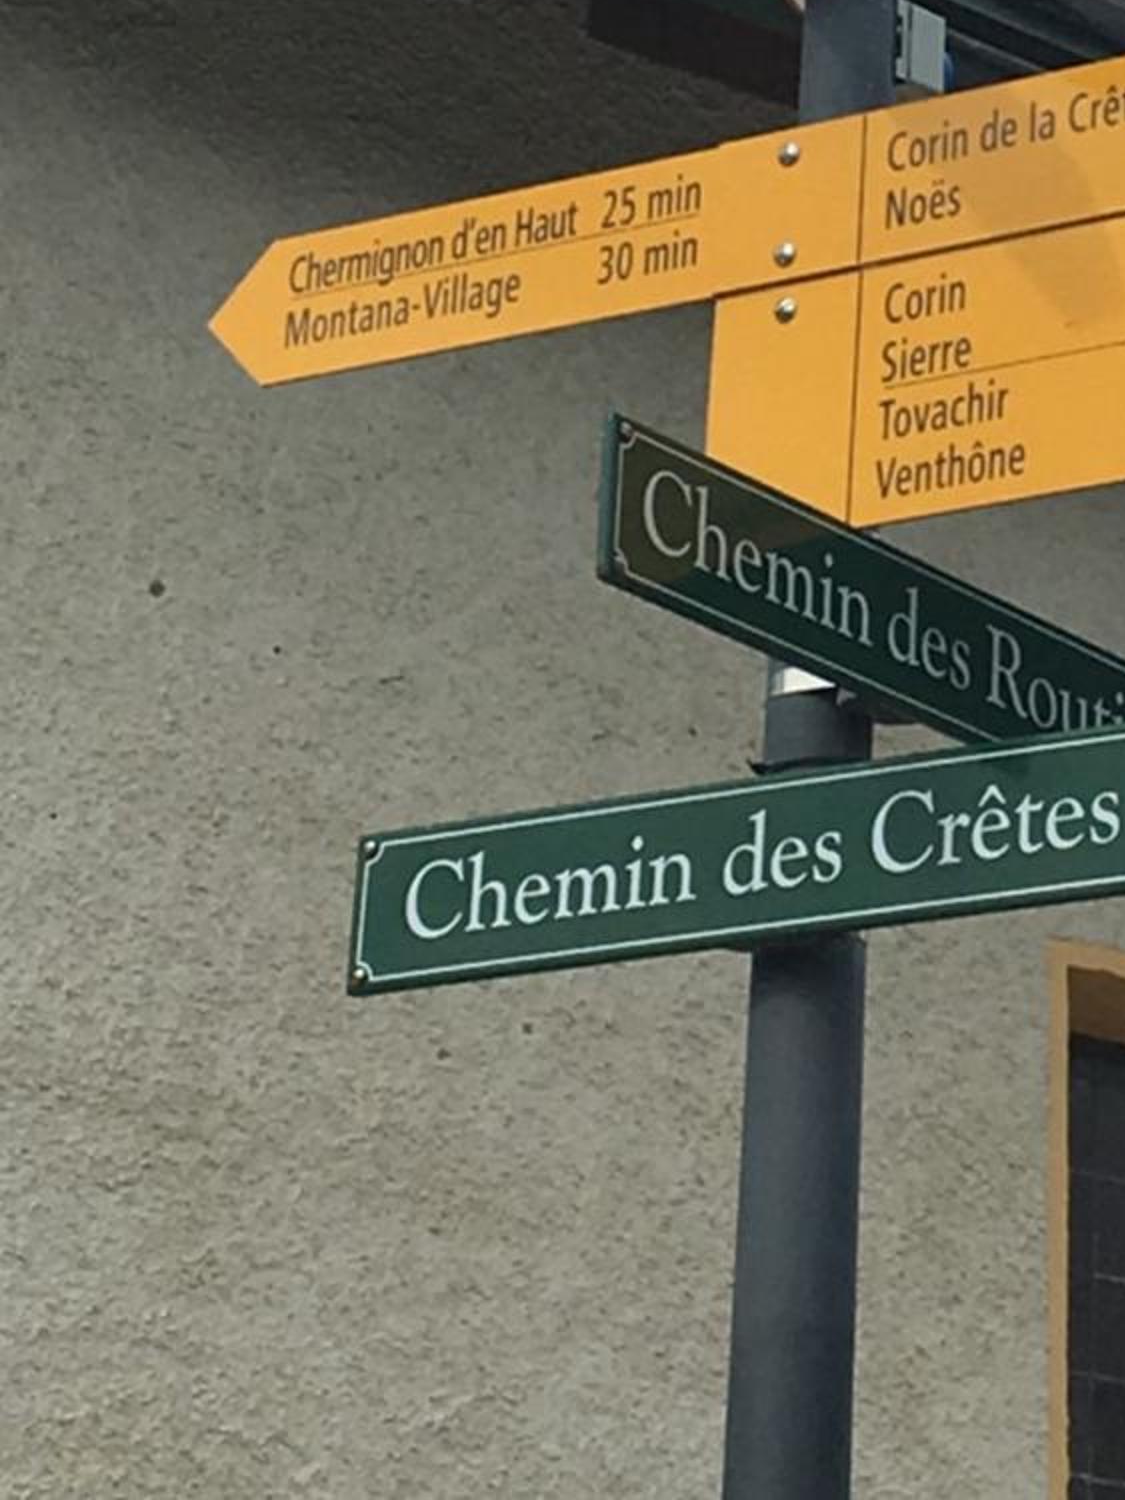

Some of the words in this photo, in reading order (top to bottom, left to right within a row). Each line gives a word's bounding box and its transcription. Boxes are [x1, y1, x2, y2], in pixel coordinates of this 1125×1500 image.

[887, 119, 968, 170] Corin
[979, 112, 1019, 153] de
[1029, 102, 1054, 141] la
[289, 234, 444, 295] Chermignon
[450, 218, 506, 260] d'en
[514, 201, 578, 245] Haut
[601, 191, 636, 229] 25
[647, 173, 702, 219] min
[885, 179, 961, 228] Noës
[285, 273, 521, 348] Montana-Village
[597, 245, 632, 284] 30
[643, 231, 698, 275] min
[885, 273, 966, 324] Corin
[882, 333, 972, 382] Sierre
[880, 380, 1009, 439] Tovachir
[876, 440, 1025, 498] Venthône
[642, 469, 872, 649] Chemin
[888, 589, 970, 689] des
[403, 836, 694, 941] Chemin
[722, 809, 843, 893] des
[871, 784, 1122, 874] Crêtes
